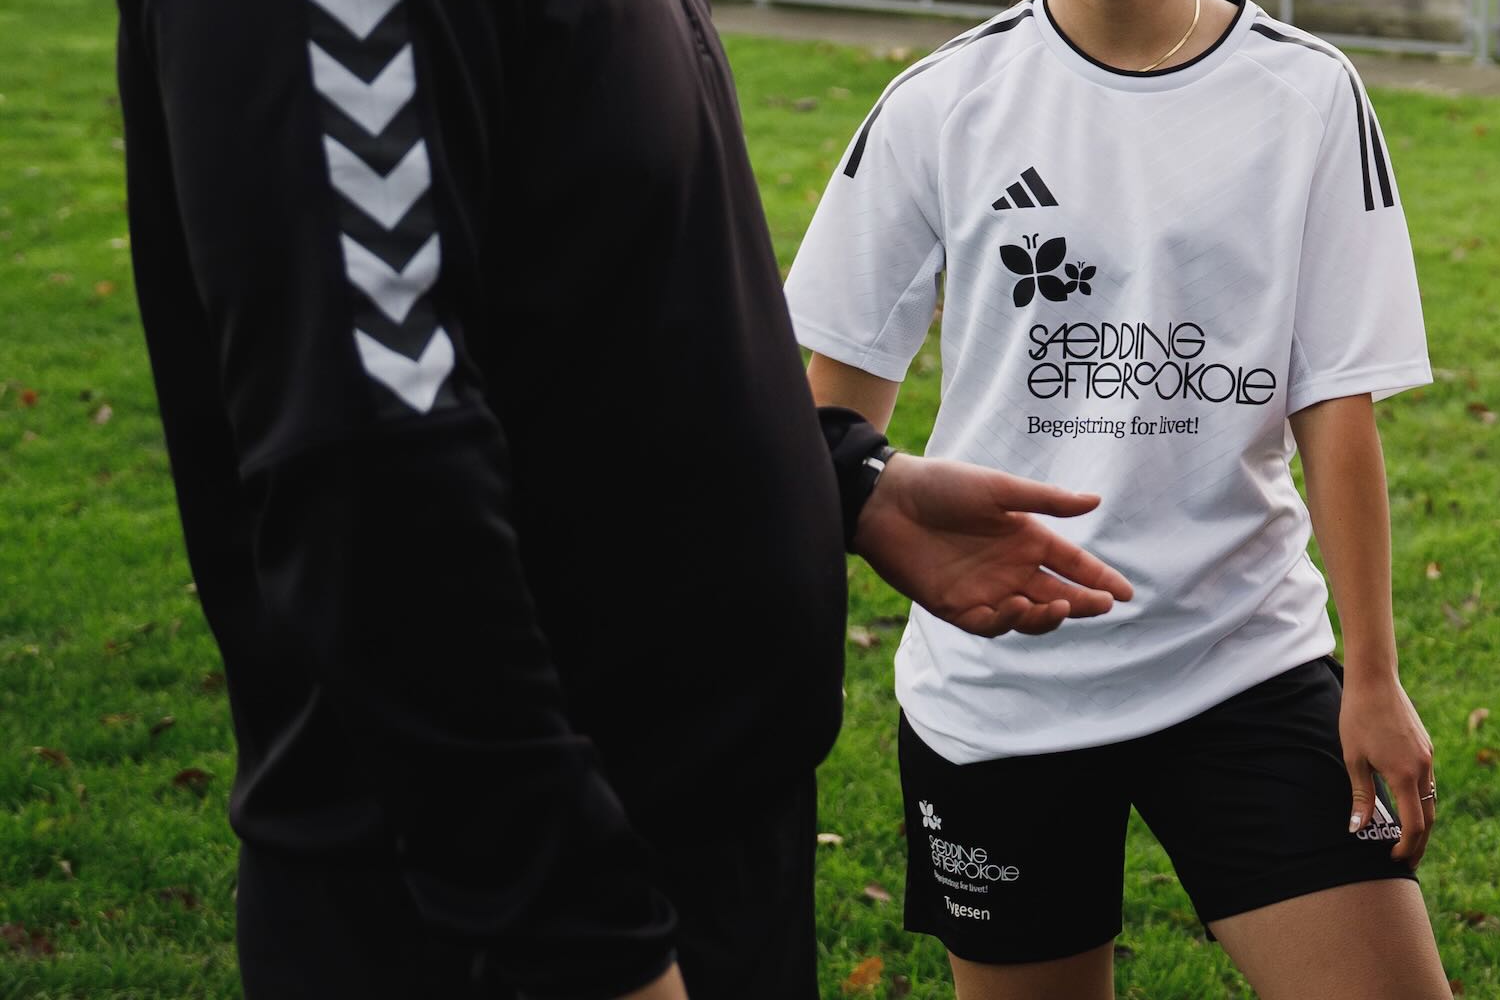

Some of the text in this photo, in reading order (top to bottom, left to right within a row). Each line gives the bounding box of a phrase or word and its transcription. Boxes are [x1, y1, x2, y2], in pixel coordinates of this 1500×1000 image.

[1027, 415, 1199, 439] Begejstring for livet!
[943, 895, 991, 921] Tygesen
